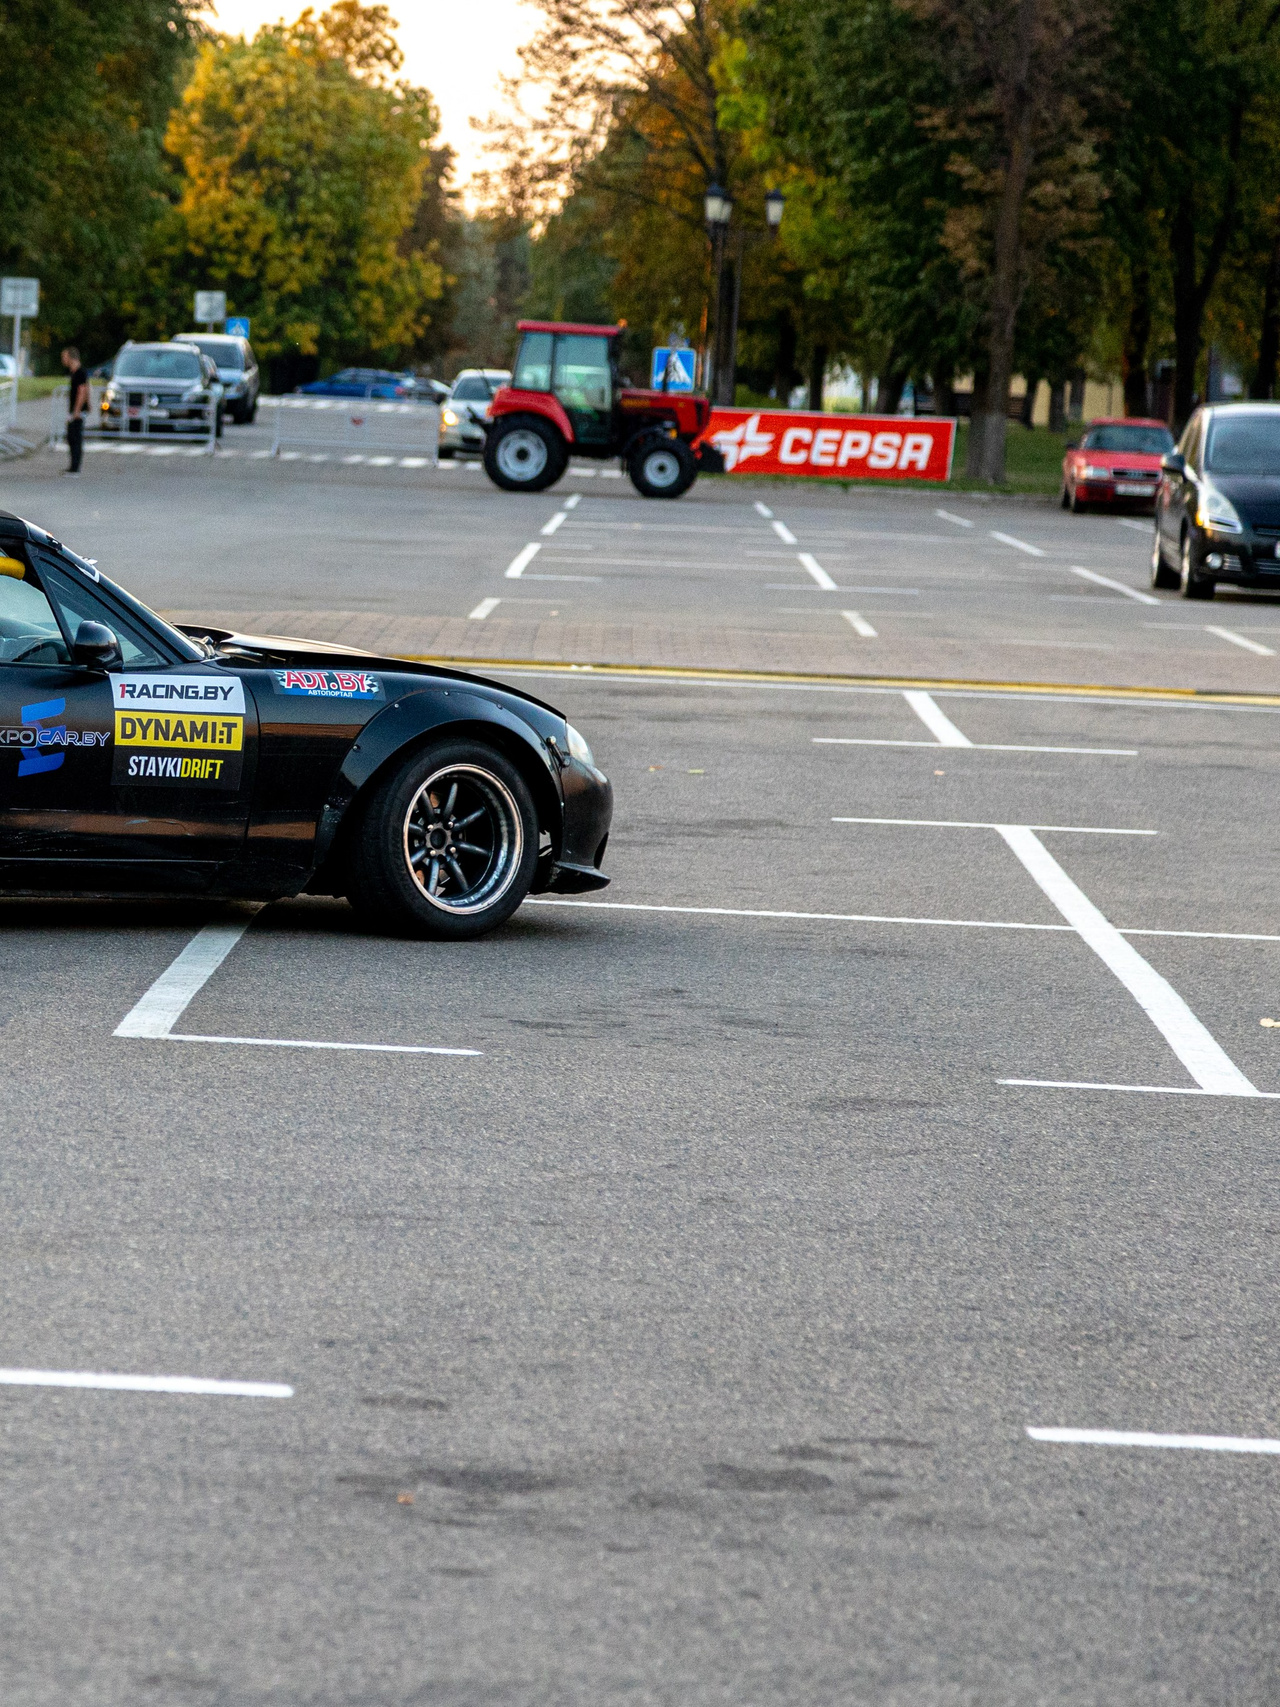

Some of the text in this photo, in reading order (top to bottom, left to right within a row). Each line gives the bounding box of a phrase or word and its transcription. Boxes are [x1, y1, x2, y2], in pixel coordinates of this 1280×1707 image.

[778, 427, 934, 471] CEPSA
[284, 671, 368, 692] ADT.BY
[119, 684, 234, 701] 1RACING.BY
[307, 689, 353, 698] АВТОПОРТАЛ
